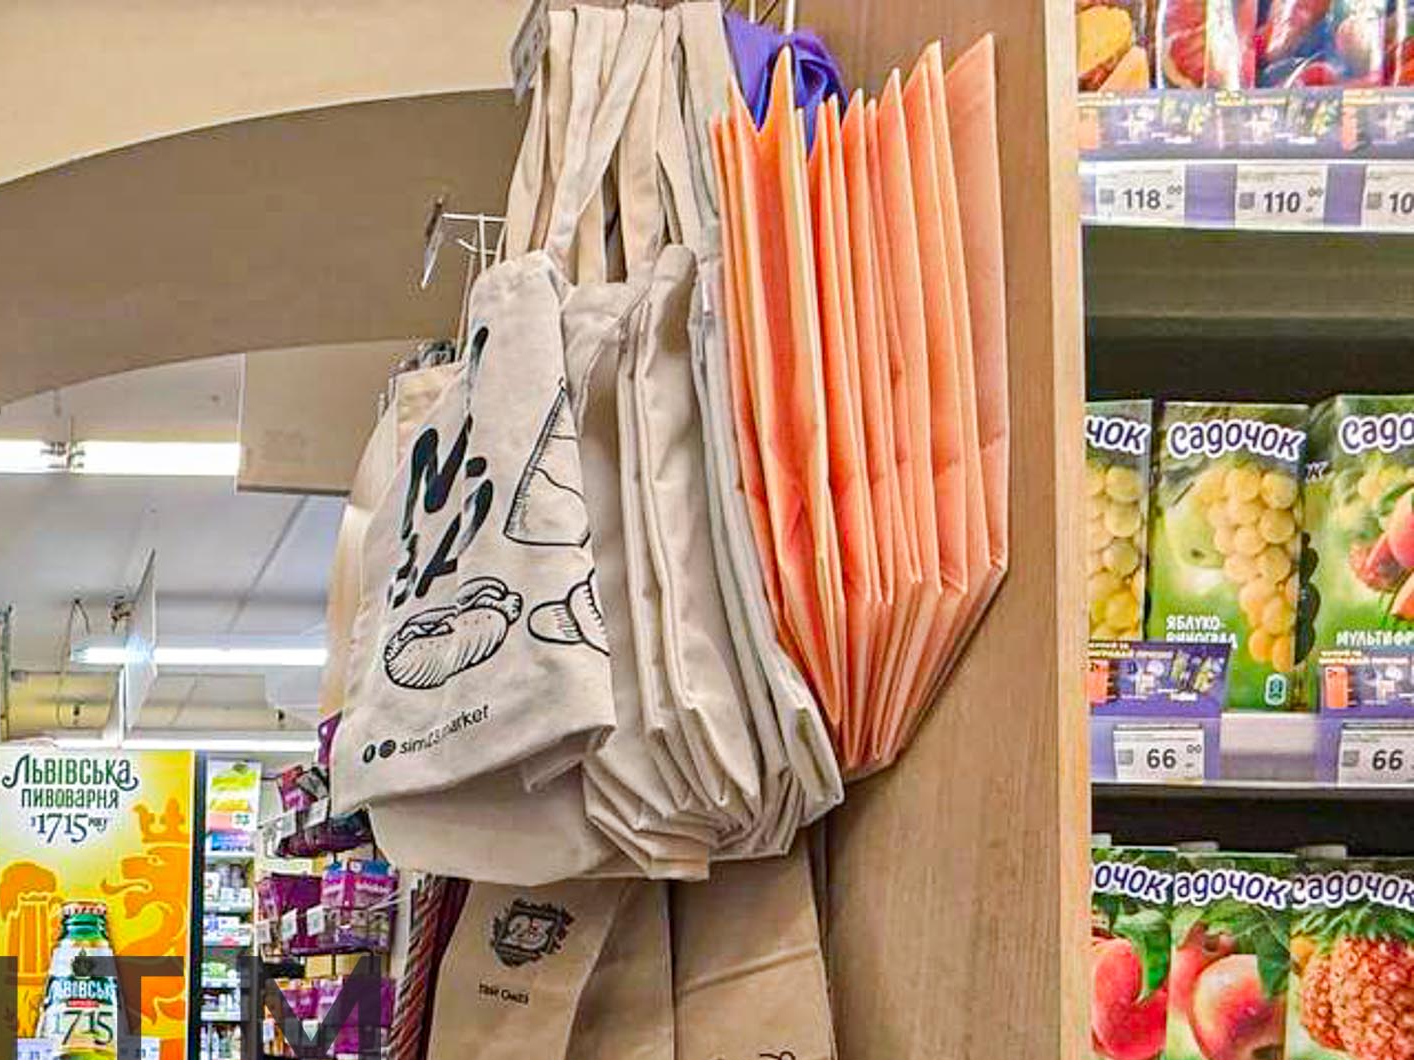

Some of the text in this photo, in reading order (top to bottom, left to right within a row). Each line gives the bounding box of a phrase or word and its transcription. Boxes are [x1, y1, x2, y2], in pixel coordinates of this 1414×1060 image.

[1124, 188, 1161, 210] 118
[1264, 192, 1301, 214] 110
[1169, 420, 1304, 458] Садочок
[1146, 749, 1177, 770] 66
[1372, 750, 1404, 771] 66
[37, 812, 88, 844] 1715
[1177, 870, 1288, 906] адочок
